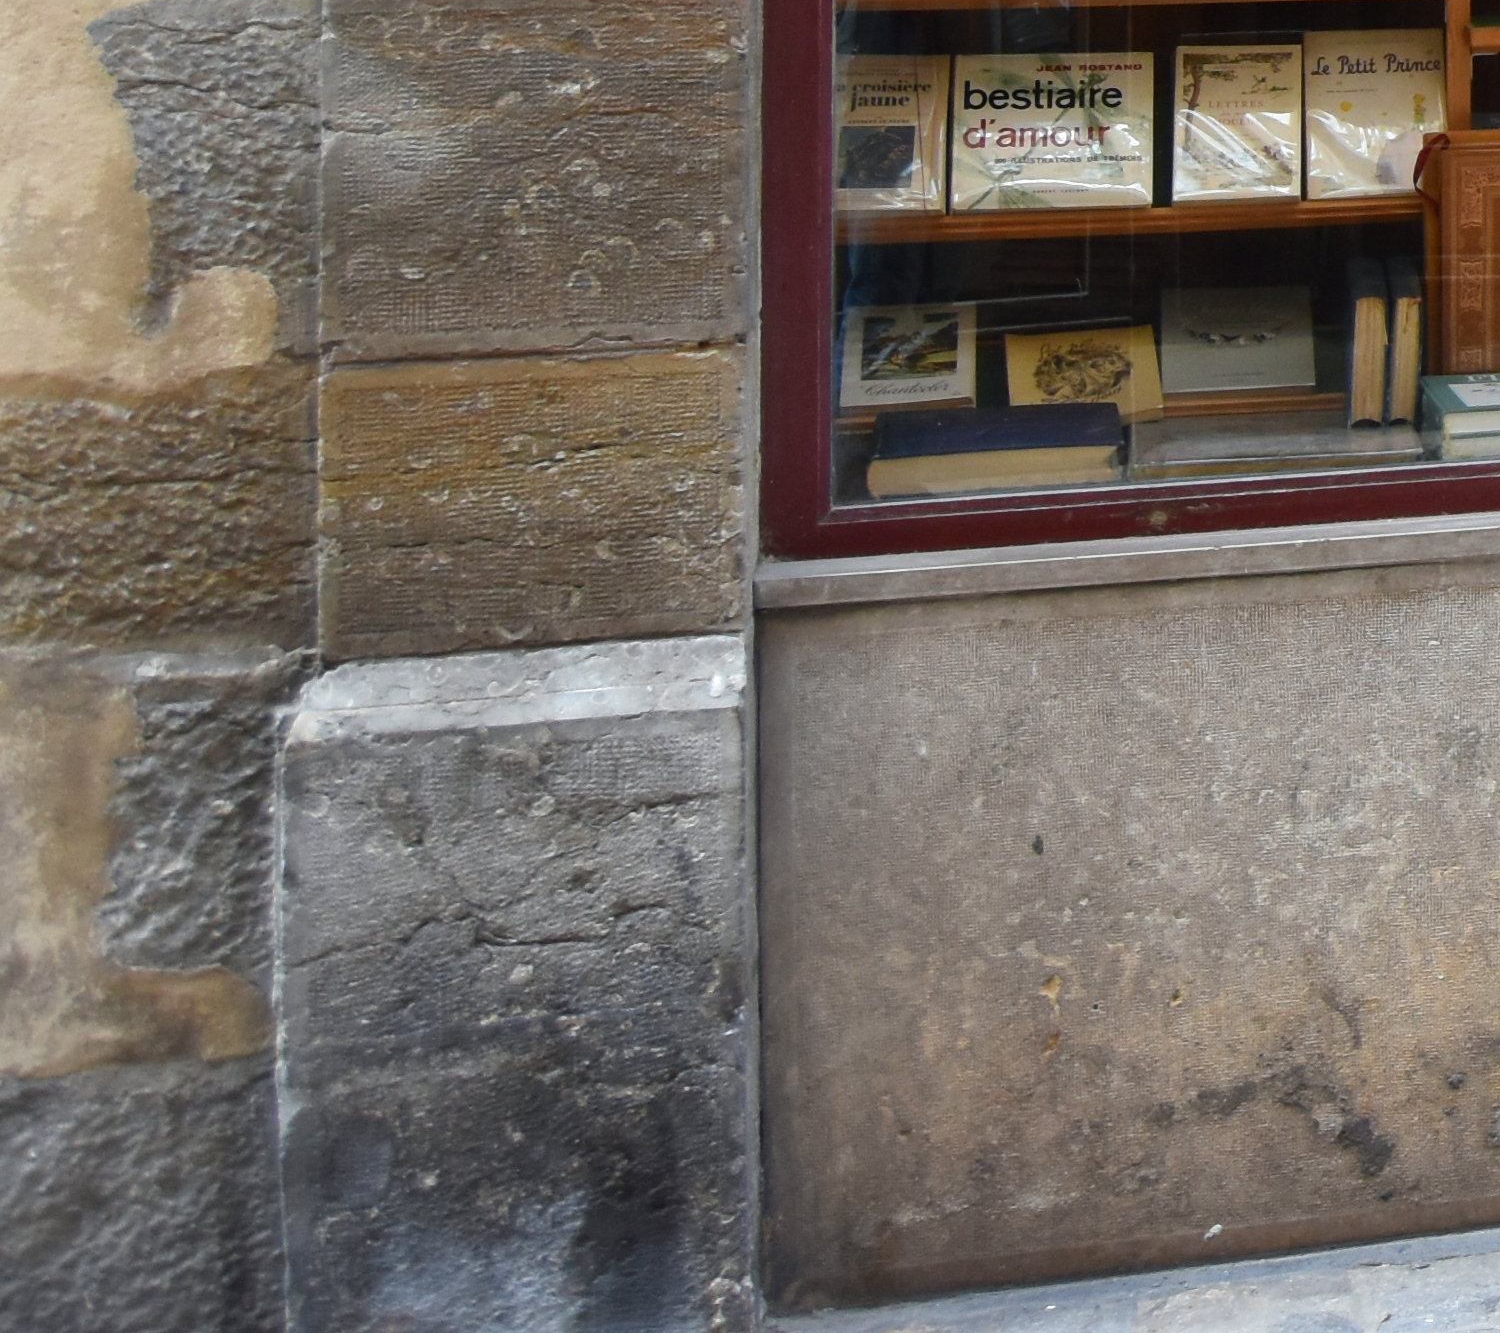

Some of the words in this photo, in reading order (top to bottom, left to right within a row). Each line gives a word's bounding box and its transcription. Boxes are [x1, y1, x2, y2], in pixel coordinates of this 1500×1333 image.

[1036, 64, 1072, 73] JEAN
[1079, 62, 1143, 72] ROSTAND
[1311, 56, 1330, 77] Le
[1337, 54, 1377, 75] Petit
[1383, 52, 1442, 73] Prince
[852, 79, 932, 94] croisière
[963, 79, 1123, 110] bestiaire
[850, 91, 910, 112] jaune
[1208, 99, 1264, 109] LETTRES
[962, 118, 1111, 149] d'amour
[1010, 155, 1082, 165] ILLUSTRATIONS
